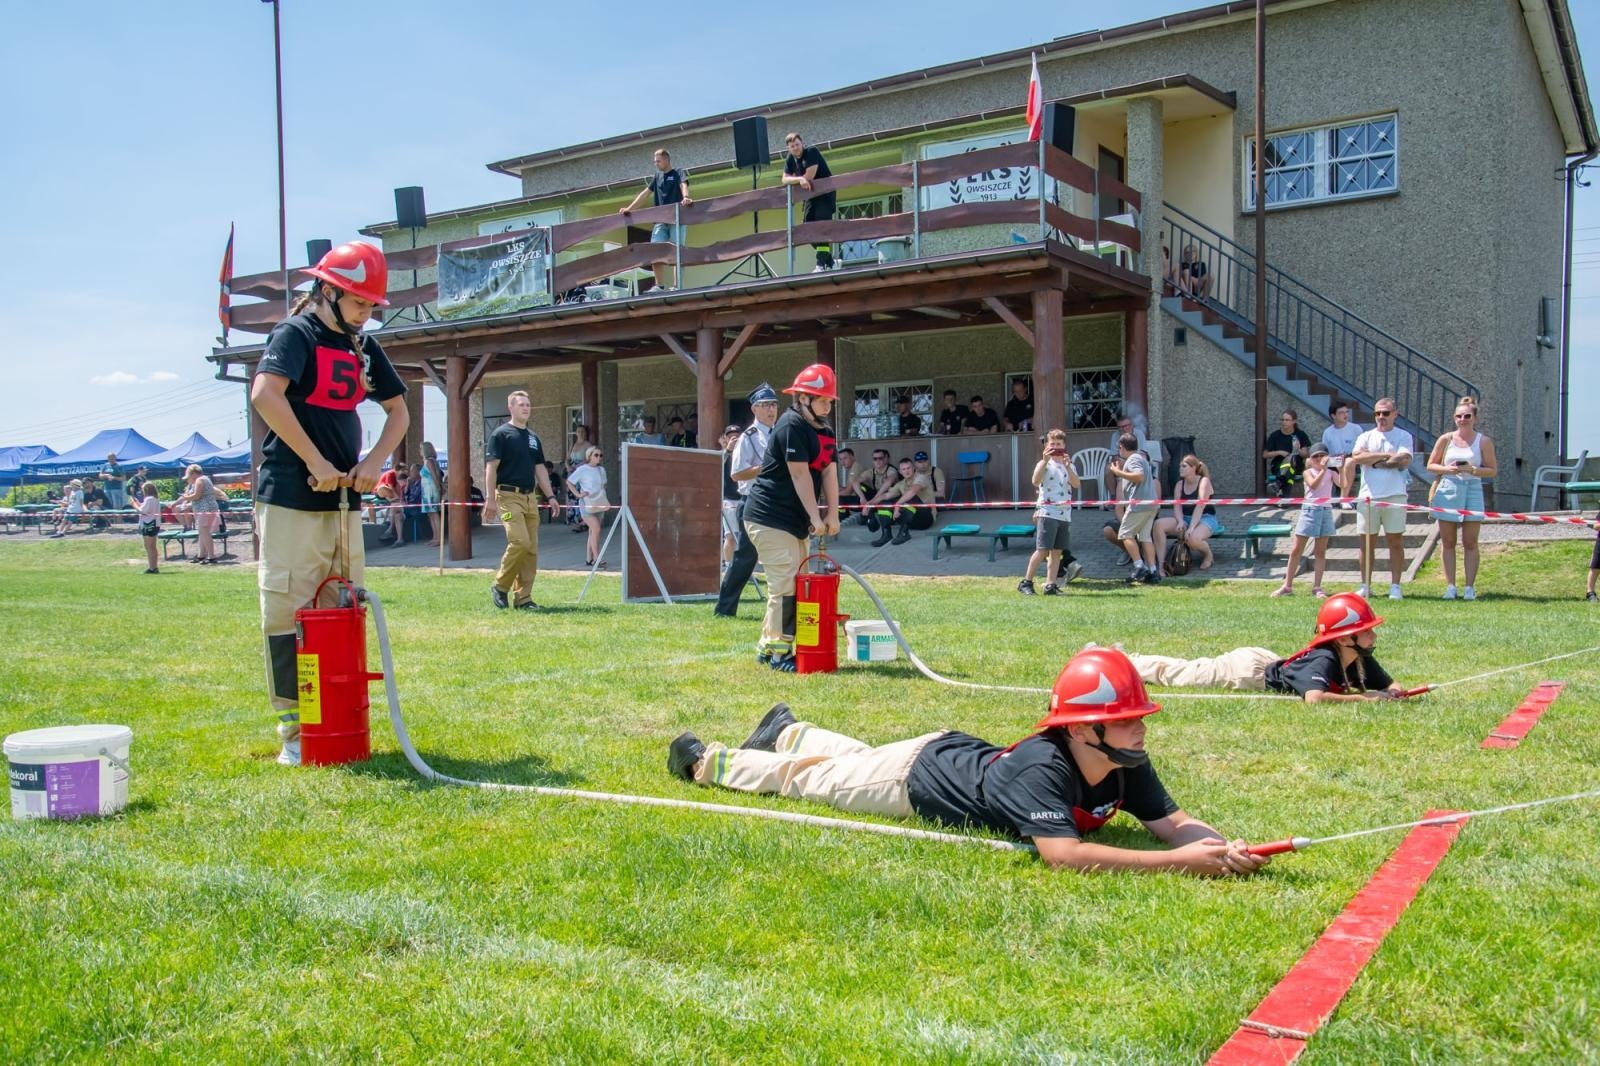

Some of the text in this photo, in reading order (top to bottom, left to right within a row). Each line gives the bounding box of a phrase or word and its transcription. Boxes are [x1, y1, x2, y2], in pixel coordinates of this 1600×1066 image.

[966, 181, 1012, 193] OWSISZCZE
[506, 242, 525, 253] LKS
[328, 360, 358, 400] 5
